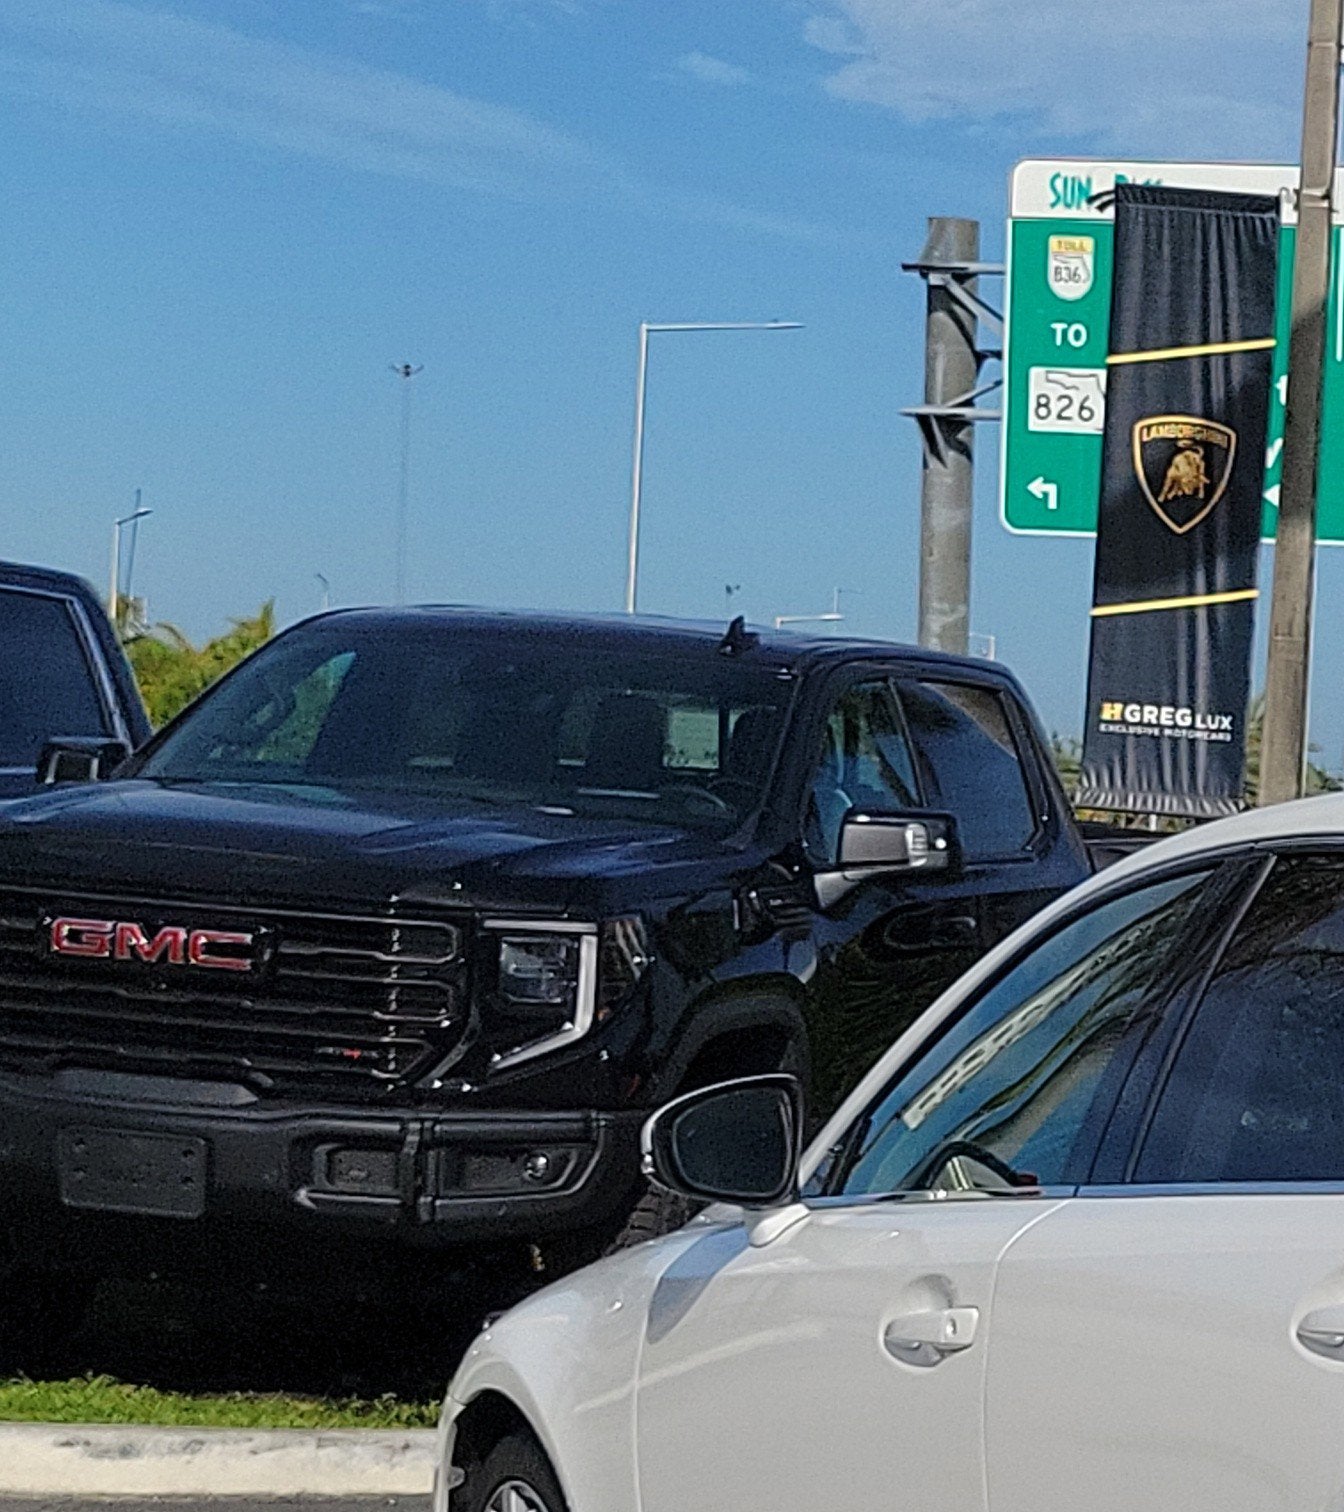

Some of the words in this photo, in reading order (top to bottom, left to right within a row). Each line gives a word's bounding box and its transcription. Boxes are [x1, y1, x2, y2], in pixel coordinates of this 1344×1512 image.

[1050, 172, 1093, 209] SUN
[1054, 265, 1082, 284] 836
[1050, 322, 1088, 347] TO
[1034, 393, 1095, 422] 826
[1194, 713, 1233, 731] LUX
[50, 916, 254, 971] GMC
